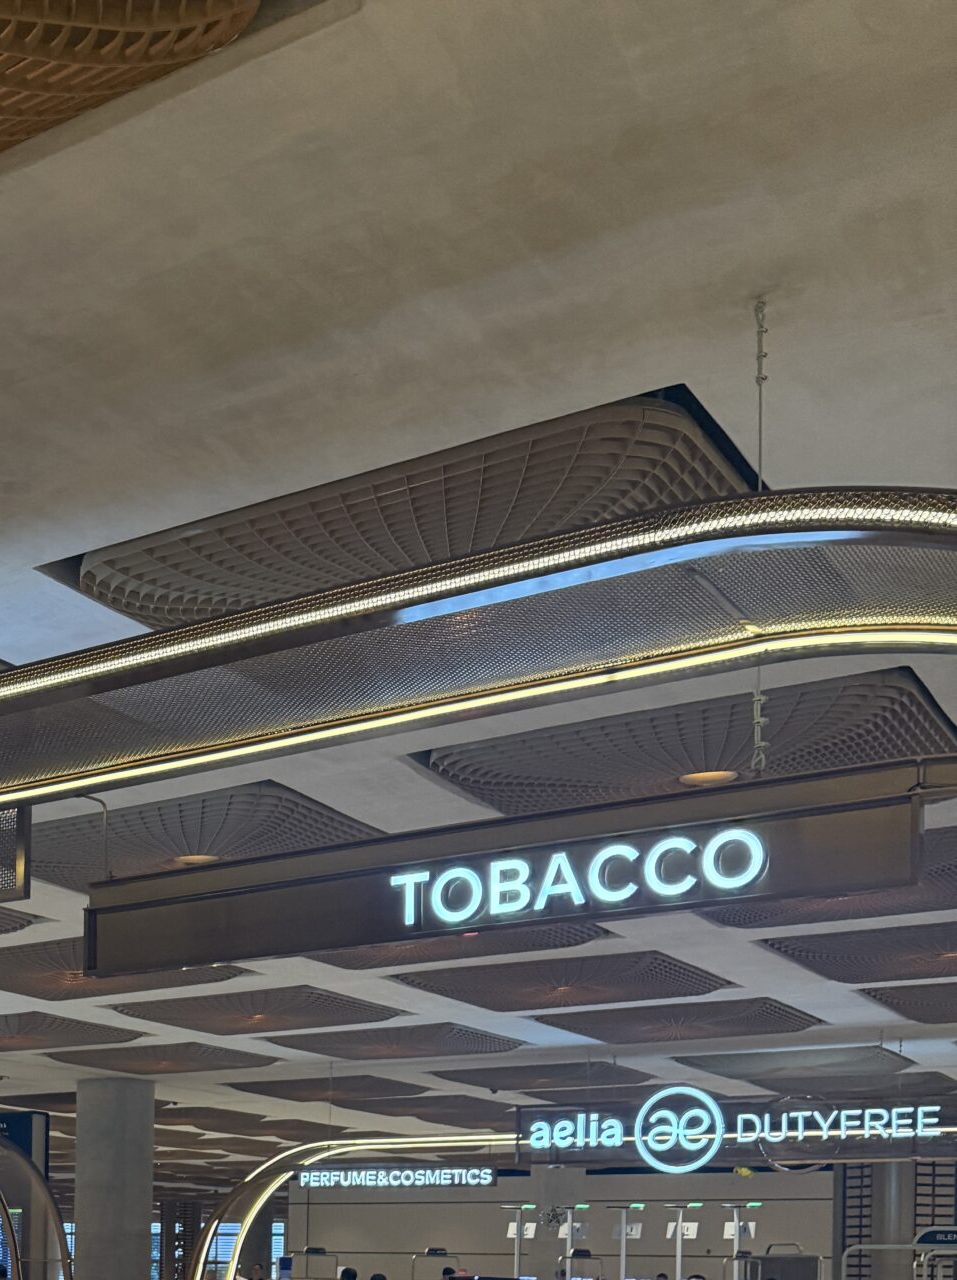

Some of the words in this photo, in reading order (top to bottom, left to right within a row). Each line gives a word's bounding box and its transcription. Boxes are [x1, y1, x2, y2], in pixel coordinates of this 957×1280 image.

[389, 828, 767, 925] TOBACCO
[529, 1112, 624, 1149] aelia
[736, 1105, 942, 1143] DUTYFREE
[299, 1167, 493, 1188] PERFUME&COSMETICS
